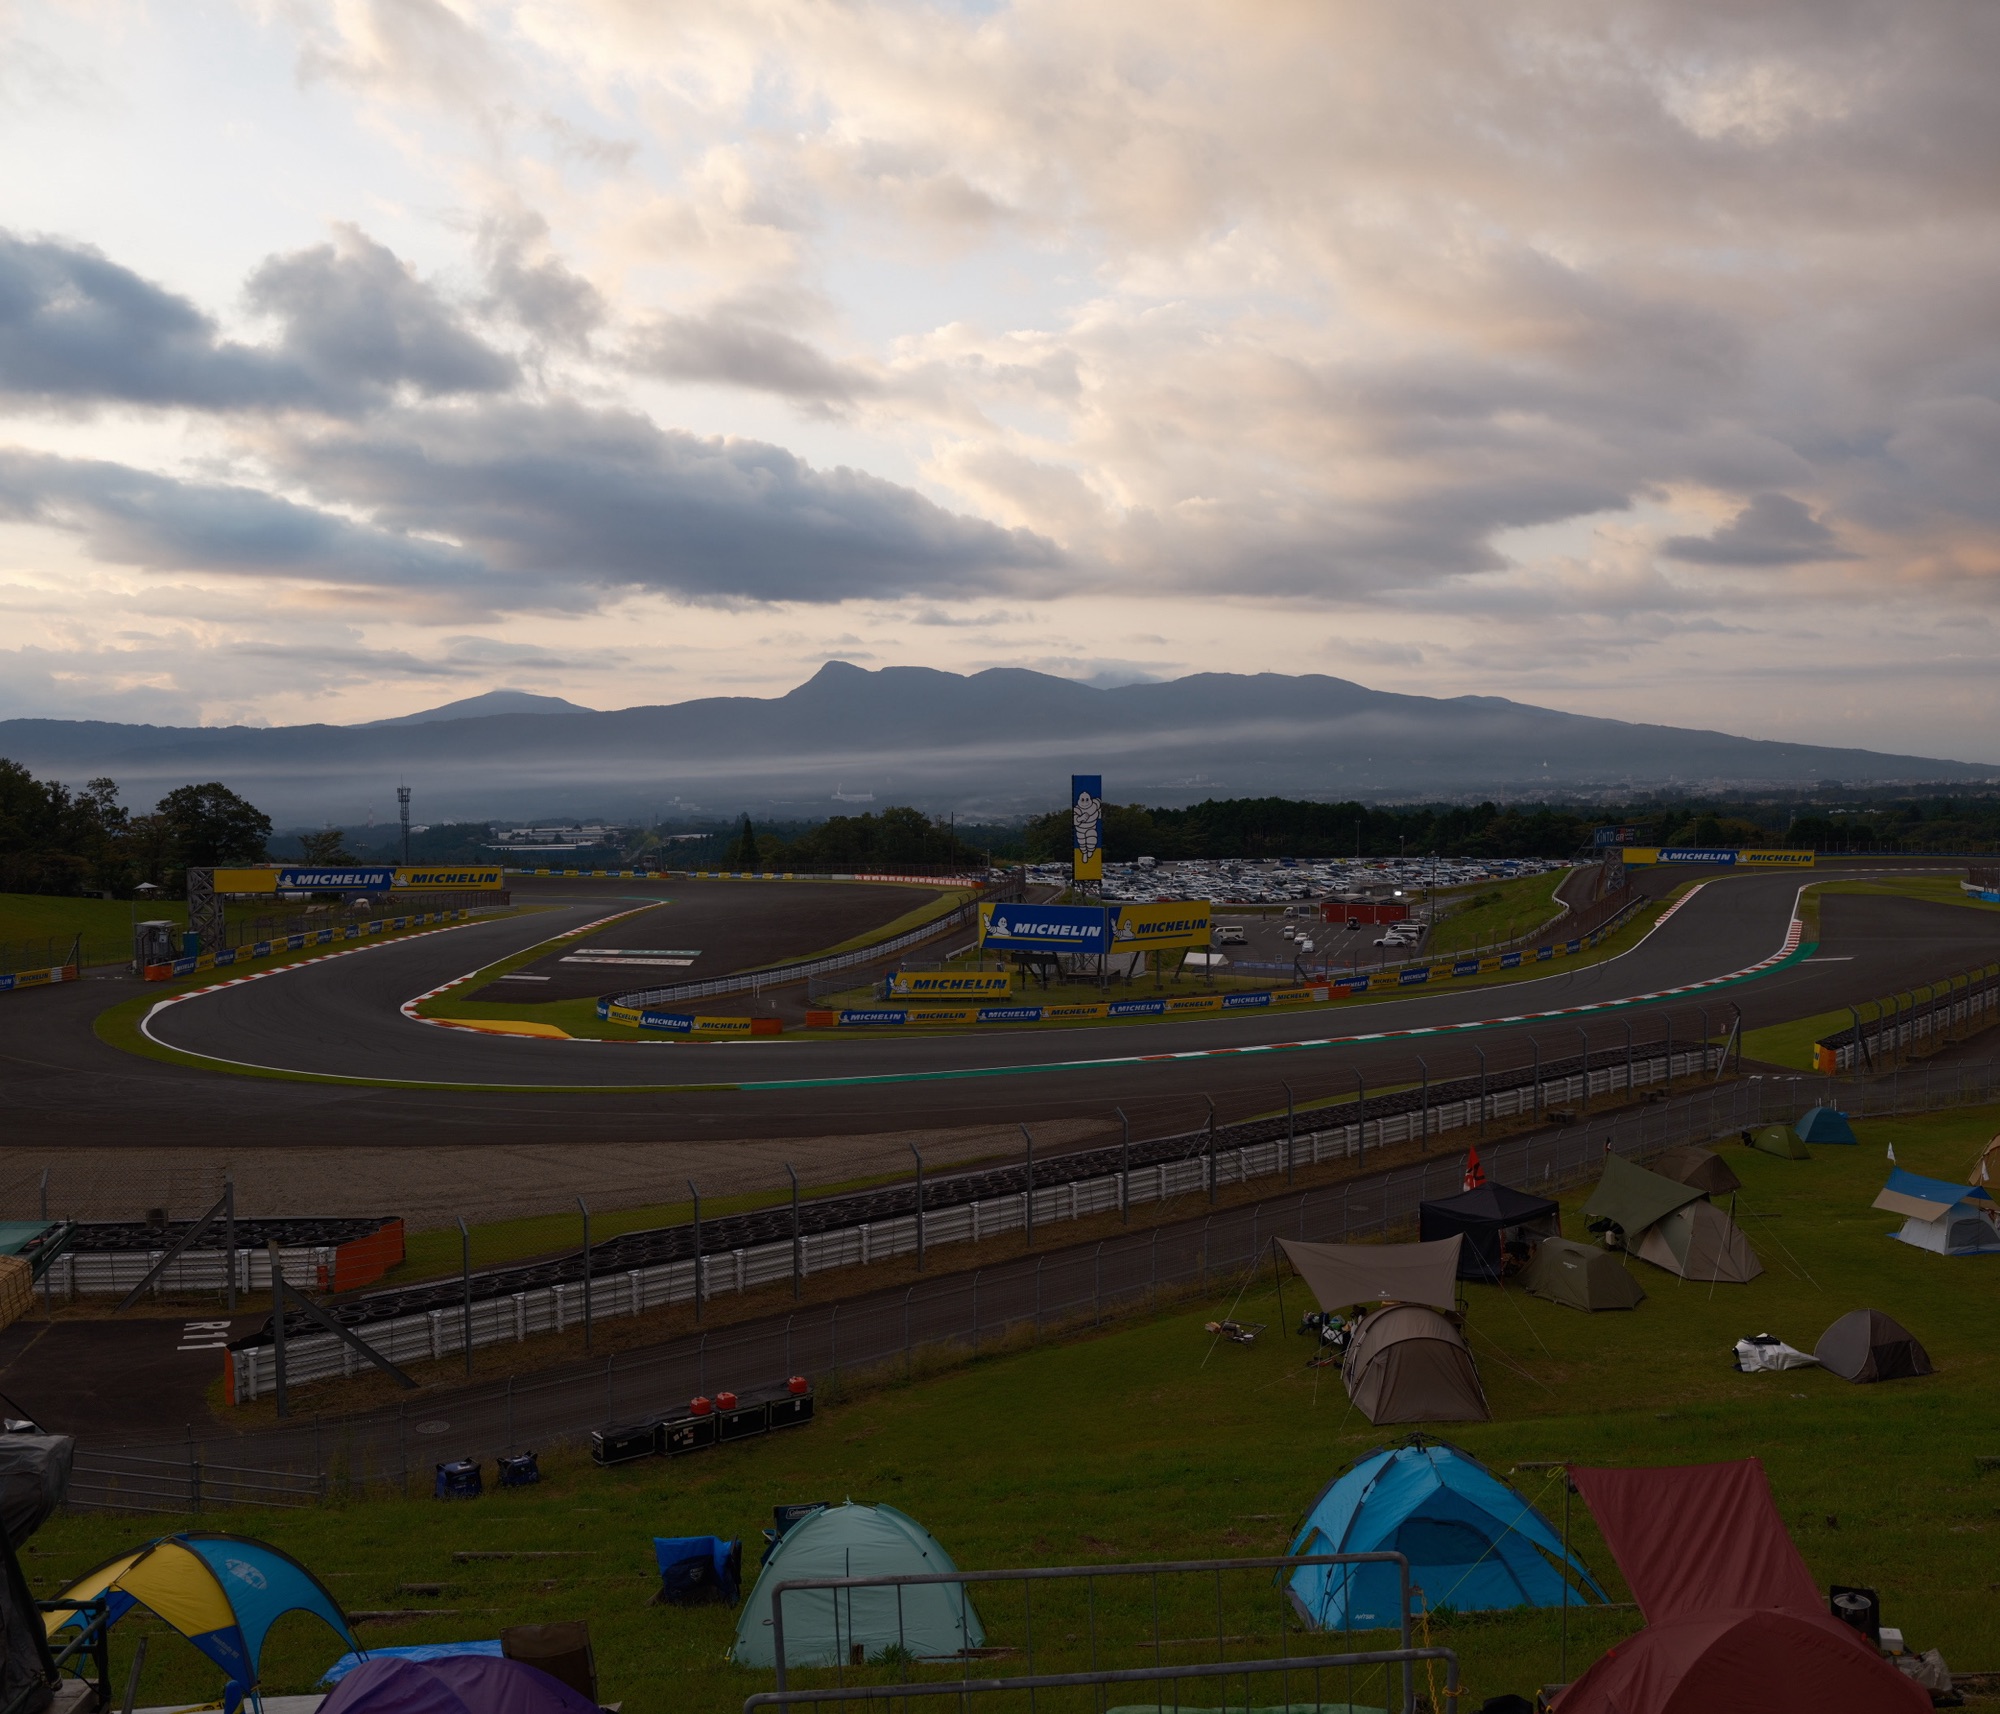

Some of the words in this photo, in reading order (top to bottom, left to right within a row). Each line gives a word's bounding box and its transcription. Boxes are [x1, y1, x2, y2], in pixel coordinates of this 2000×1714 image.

[1669, 851, 1731, 861] MICHELIN
[1749, 853, 1812, 863] MICHELIN
[296, 873, 384, 885] MICHELIN
[410, 873, 498, 884] MICHELIN
[1013, 922, 1101, 938] MICHELIN
[1137, 918, 1207, 934] MICHELIN
[20, 972, 49, 982] MICHELIN
[913, 978, 1007, 990] MICHELIN
[1229, 995, 1267, 1005] MICHELIN
[1277, 992, 1310, 1000] MICHELIN
[1117, 1003, 1162, 1012] MICHELIN
[1173, 1000, 1213, 1009] MICHELIN
[611, 1011, 639, 1021] MICHELIN
[851, 1012, 901, 1021] MICHELIN
[916, 1012, 966, 1020] MICHELIN
[988, 1010, 1038, 1019] MICHELIN
[1051, 1007, 1098, 1017] MICHELIN
[647, 1017, 689, 1028] MICHELIN
[701, 1022, 750, 1030] MICHELIN
[176, 1320, 231, 1350] R11
